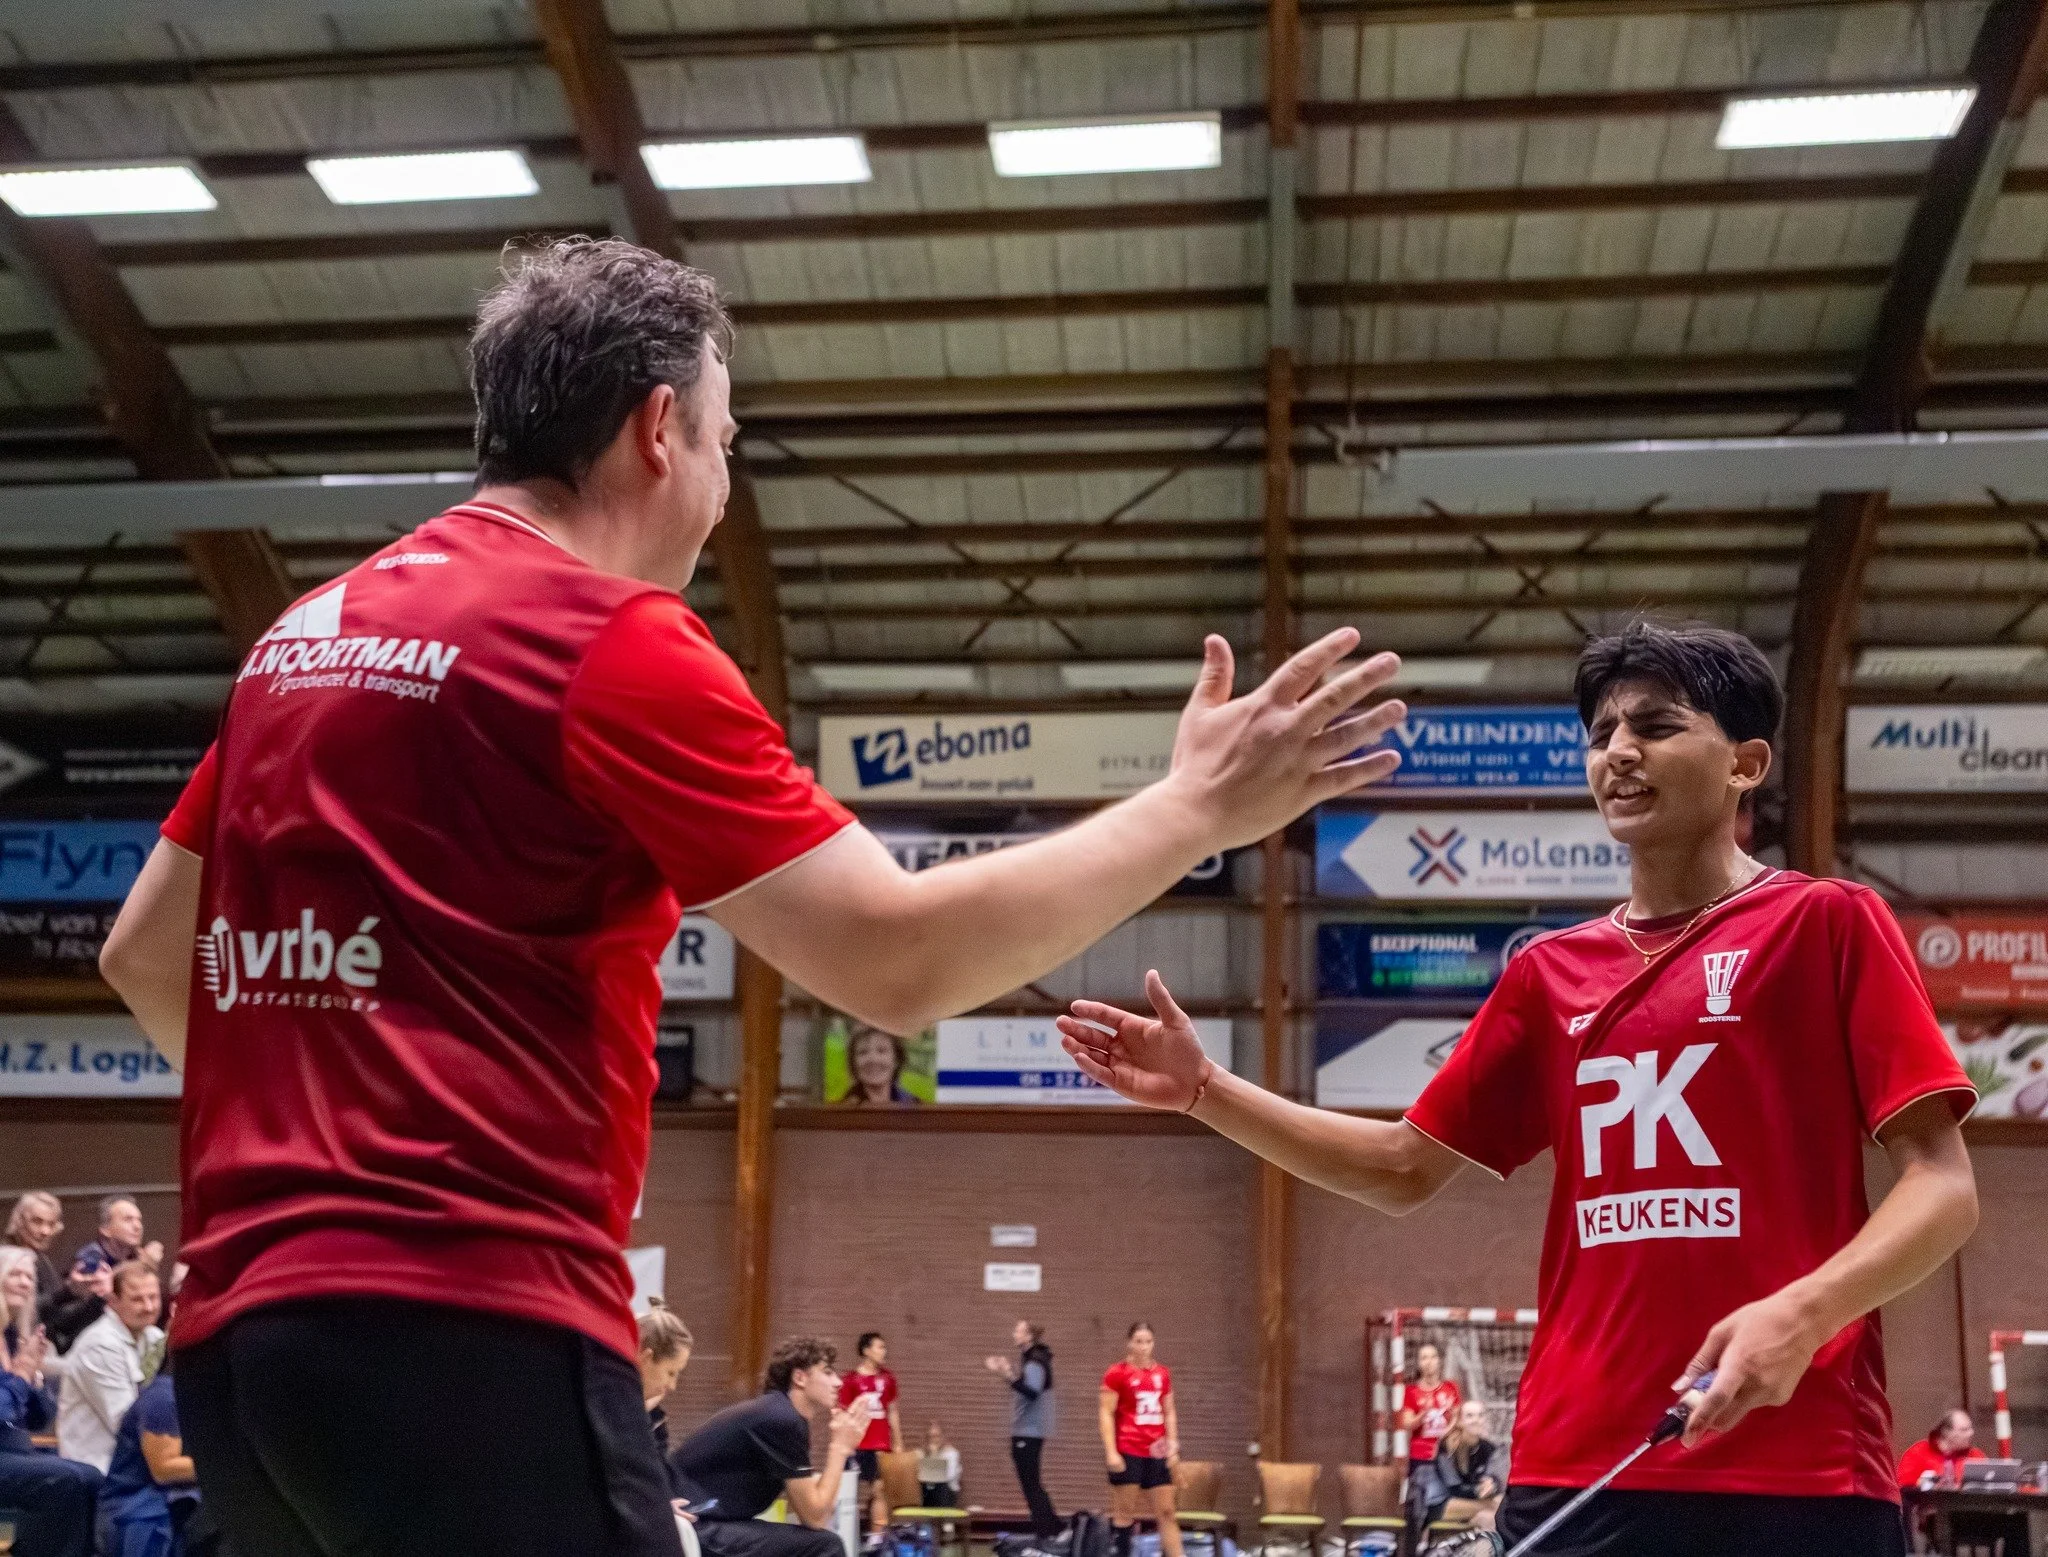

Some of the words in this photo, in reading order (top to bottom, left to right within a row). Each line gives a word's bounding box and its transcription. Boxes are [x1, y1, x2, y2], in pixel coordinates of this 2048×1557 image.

[348, 670, 364, 688] &
[364, 673, 440, 704] transport
[1396, 719, 1587, 748] VRIENDEN
[1871, 718, 1978, 750] Multi
[1481, 837, 1632, 867] Molenaa
[238, 908, 383, 987] vrbé
[1370, 934, 1478, 953] EXCEPTIONAL
[1698, 1015, 1741, 1023] ROOSTEREN
[1576, 1043, 1722, 1178] PK
[1581, 1197, 1736, 1238] KEUKENS
